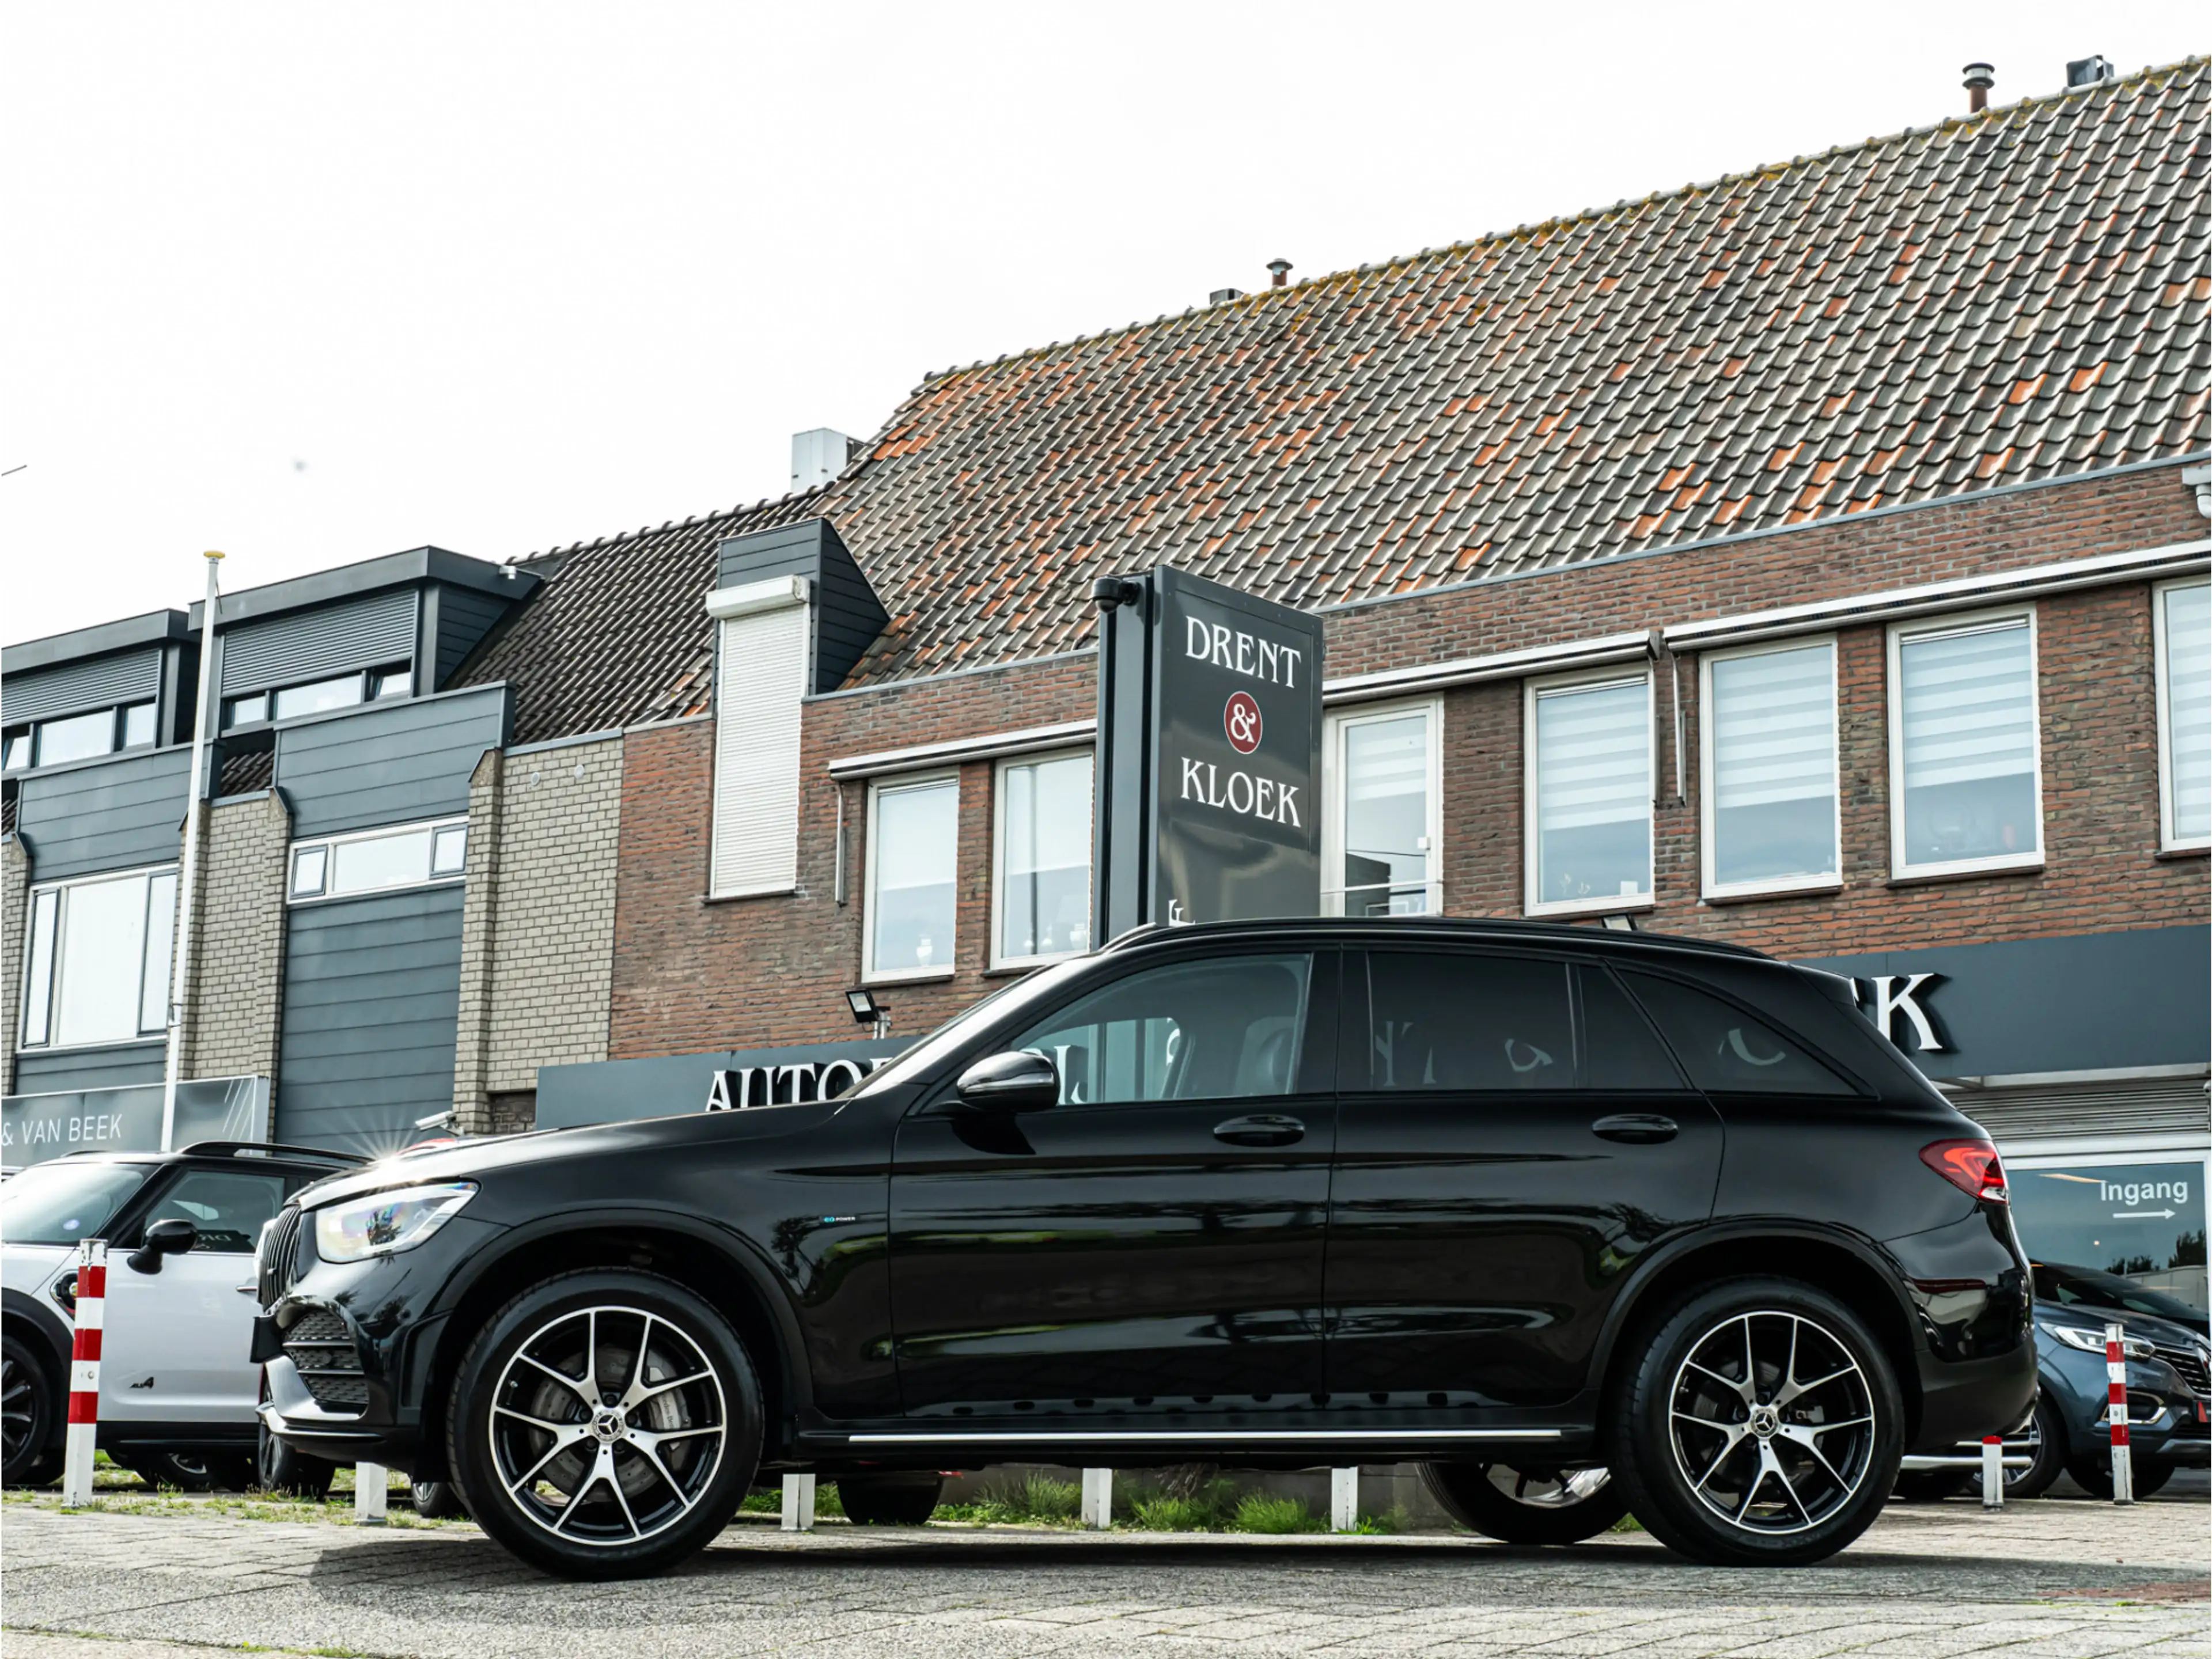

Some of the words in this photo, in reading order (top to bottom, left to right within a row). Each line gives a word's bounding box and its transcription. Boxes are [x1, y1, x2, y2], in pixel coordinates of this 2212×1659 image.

[1185, 615, 1302, 689] DRENT
[1230, 703, 1256, 743] &
[1181, 756, 1302, 828] KLOEK
[22, 1118, 60, 1145] VAN
[69, 1114, 122, 1142] BEEK
[2100, 1180, 2188, 1206] Ingang
